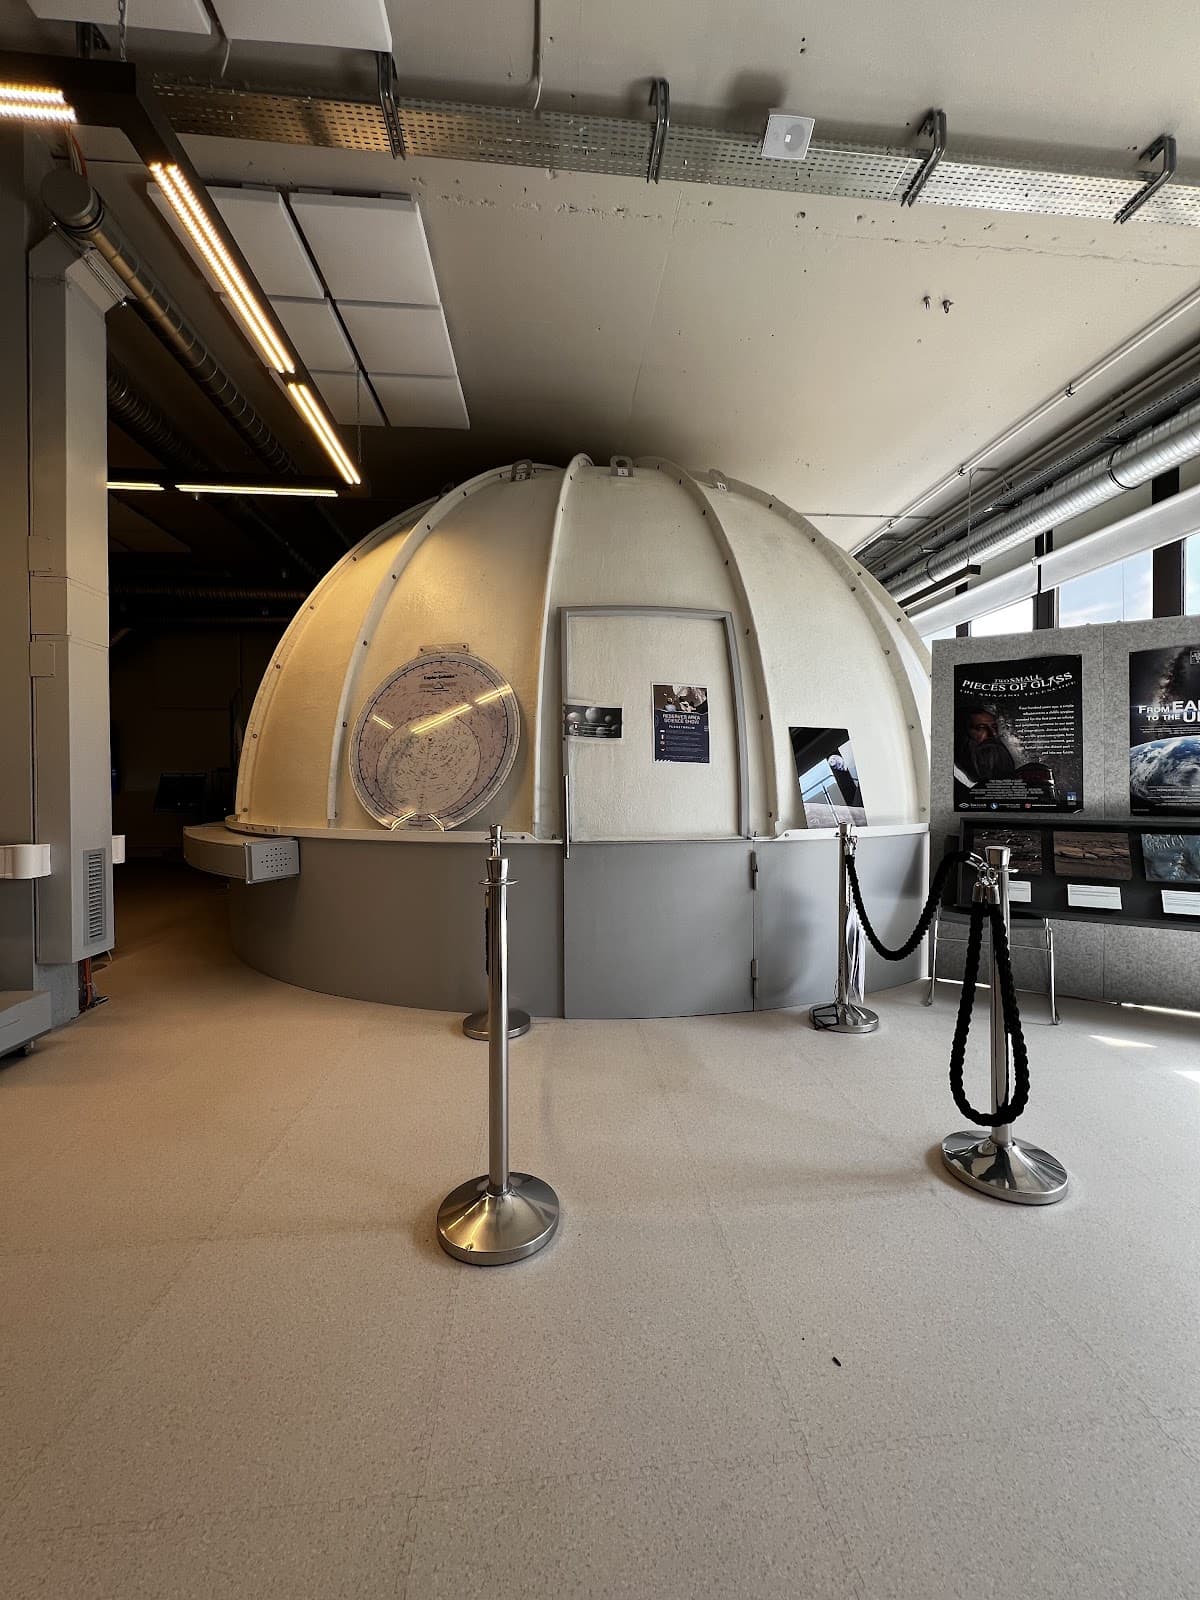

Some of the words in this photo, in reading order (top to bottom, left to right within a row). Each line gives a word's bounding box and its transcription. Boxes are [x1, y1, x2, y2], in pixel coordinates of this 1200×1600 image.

[962, 680, 1006, 692] PIECES
[1009, 683, 1027, 691] OF
[1030, 672, 1073, 689] GLASS
[1009, 674, 1042, 683] SMALL
[1138, 705, 1170, 714] FROM
[1172, 700, 1200, 712] EA
[1183, 711, 1200, 723] U
